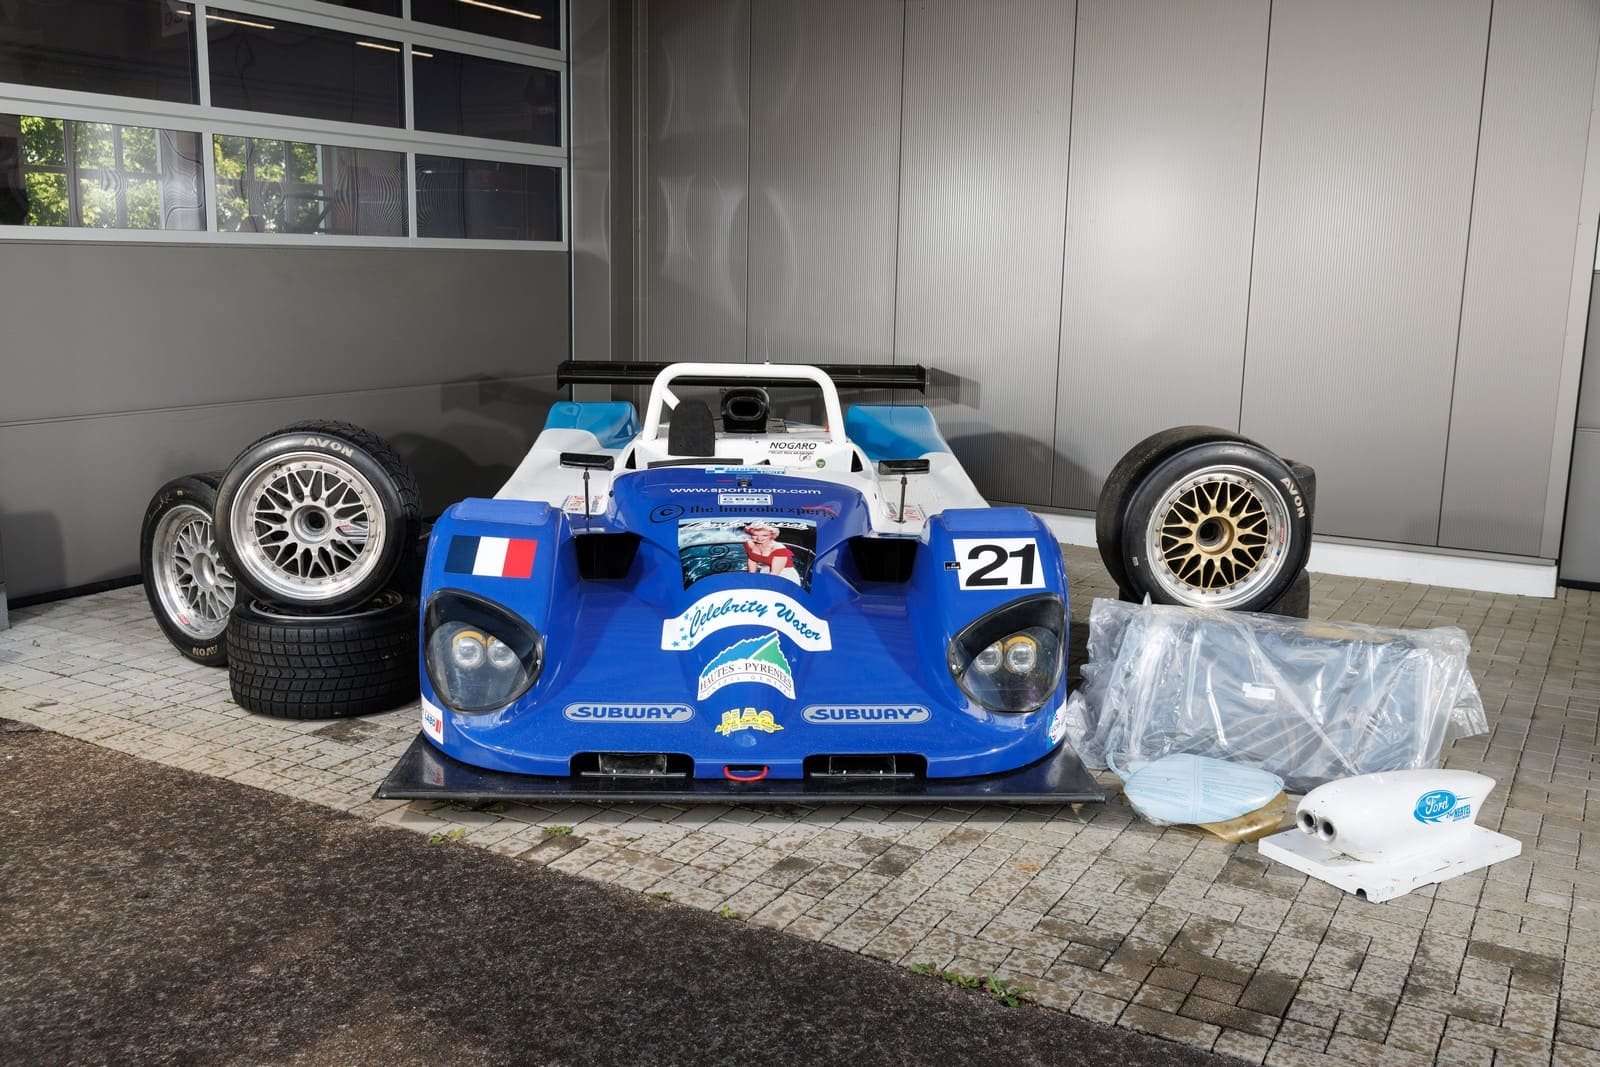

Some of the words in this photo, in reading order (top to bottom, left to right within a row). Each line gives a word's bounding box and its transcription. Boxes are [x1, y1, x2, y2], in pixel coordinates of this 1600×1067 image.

[303, 436, 354, 458] AVON
[769, 441, 817, 450] NOGARO
[669, 485, 822, 496] www.sportproto.com
[1279, 476, 1306, 519] AVON
[965, 543, 1036, 587] 21
[689, 597, 769, 638] Celebrity
[774, 602, 822, 641] Water
[571, 706, 688, 719] SUBWAY
[809, 707, 923, 720] SUBWAY
[1425, 794, 1450, 815] Ford
